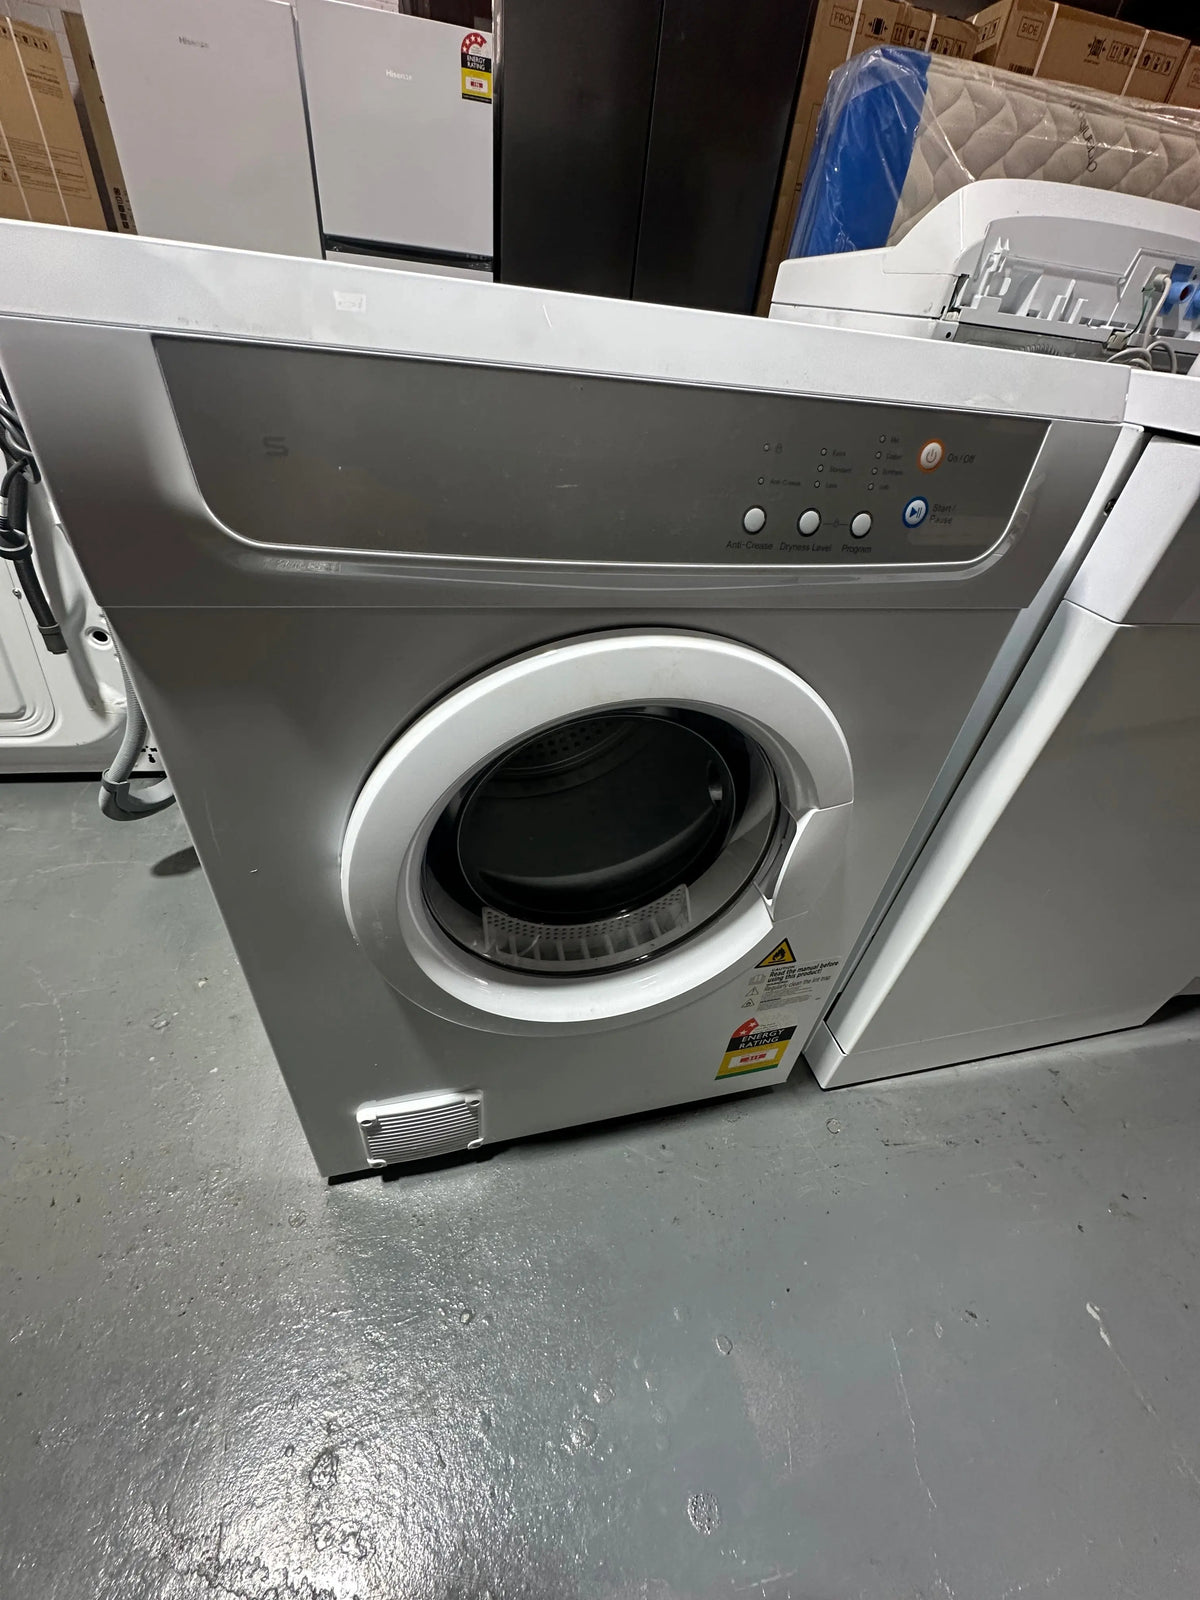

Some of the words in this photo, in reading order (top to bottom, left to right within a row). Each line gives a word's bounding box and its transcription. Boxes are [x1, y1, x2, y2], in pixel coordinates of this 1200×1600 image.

[833, 11, 860, 27] FRON
[1021, 23, 1039, 37] SIDE
[466, 54, 486, 64] ENERGY
[466, 61, 486, 71] RATING
[385, 69, 412, 81] Hisense
[929, 514, 952, 525] Pause
[726, 540, 774, 551] Anti-Crease
[779, 541, 811, 552] Dryness
[811, 543, 832, 553] Level
[841, 544, 873, 554] Program
[769, 968, 786, 978] Read
[786, 967, 797, 975] the
[797, 963, 819, 973] manual
[819, 960, 839, 970] before
[767, 975, 784, 983] using
[785, 972, 796, 980] this
[741, 1029, 784, 1042] ENERGY
[738, 1036, 779, 1049] RATING
